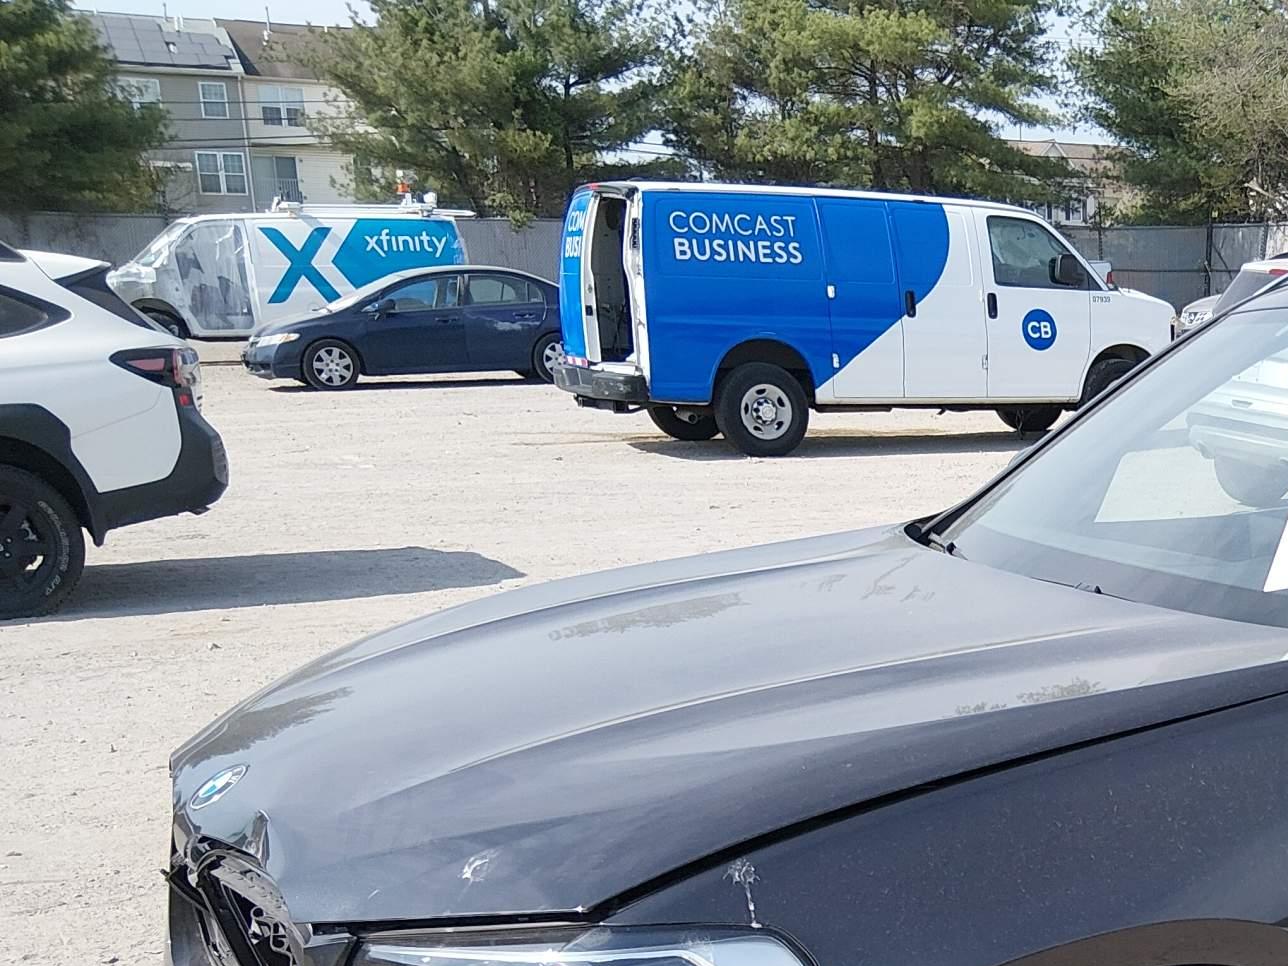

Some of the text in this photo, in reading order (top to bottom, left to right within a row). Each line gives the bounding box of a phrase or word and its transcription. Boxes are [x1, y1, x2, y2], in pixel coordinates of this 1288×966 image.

[669, 211, 796, 238] COMCAST
[364, 229, 446, 257] xfinity
[673, 238, 803, 264] BUSINESS
[1027, 321, 1052, 338] CB
